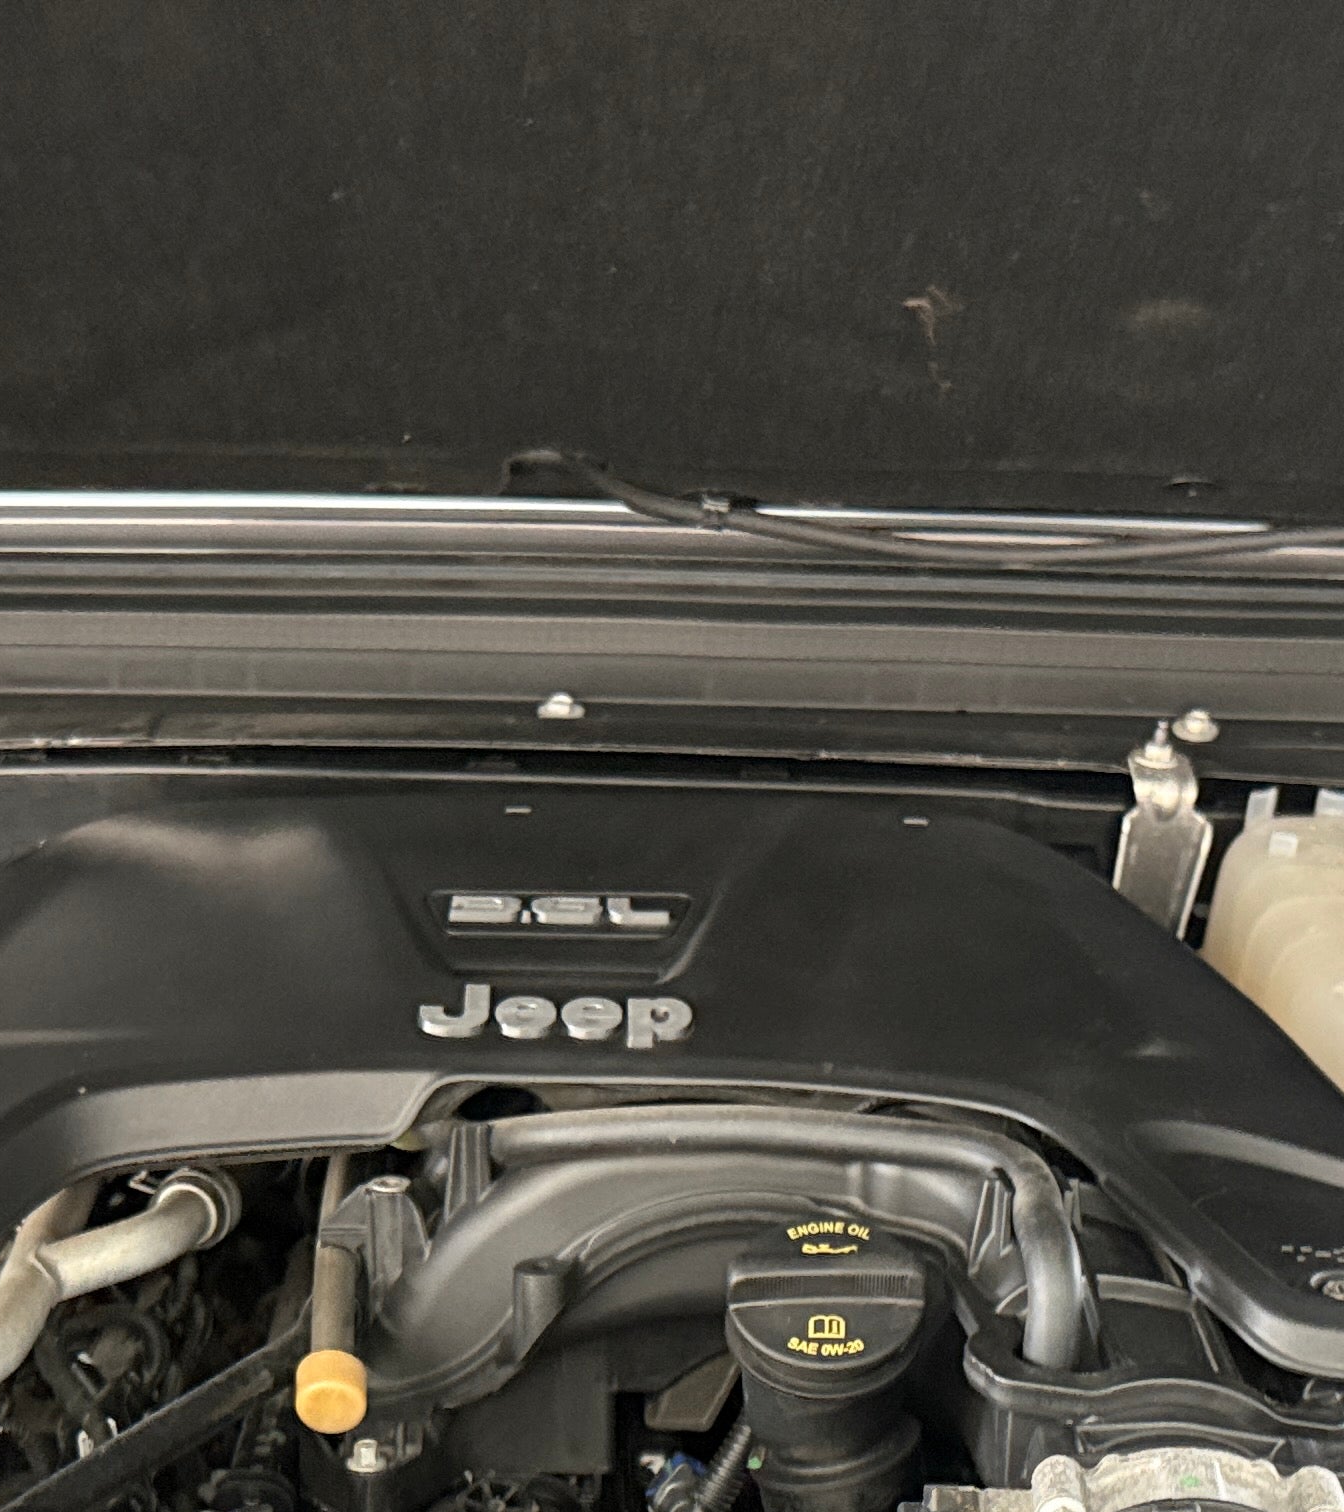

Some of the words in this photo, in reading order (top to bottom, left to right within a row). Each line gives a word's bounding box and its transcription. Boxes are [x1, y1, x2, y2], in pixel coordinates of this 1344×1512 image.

[418, 983, 694, 1049] Jeep
[786, 1221, 845, 1241] ENGINE
[847, 1221, 871, 1242] OIL
[787, 1336, 819, 1357] SAE
[820, 1338, 865, 1358] 0W-20
